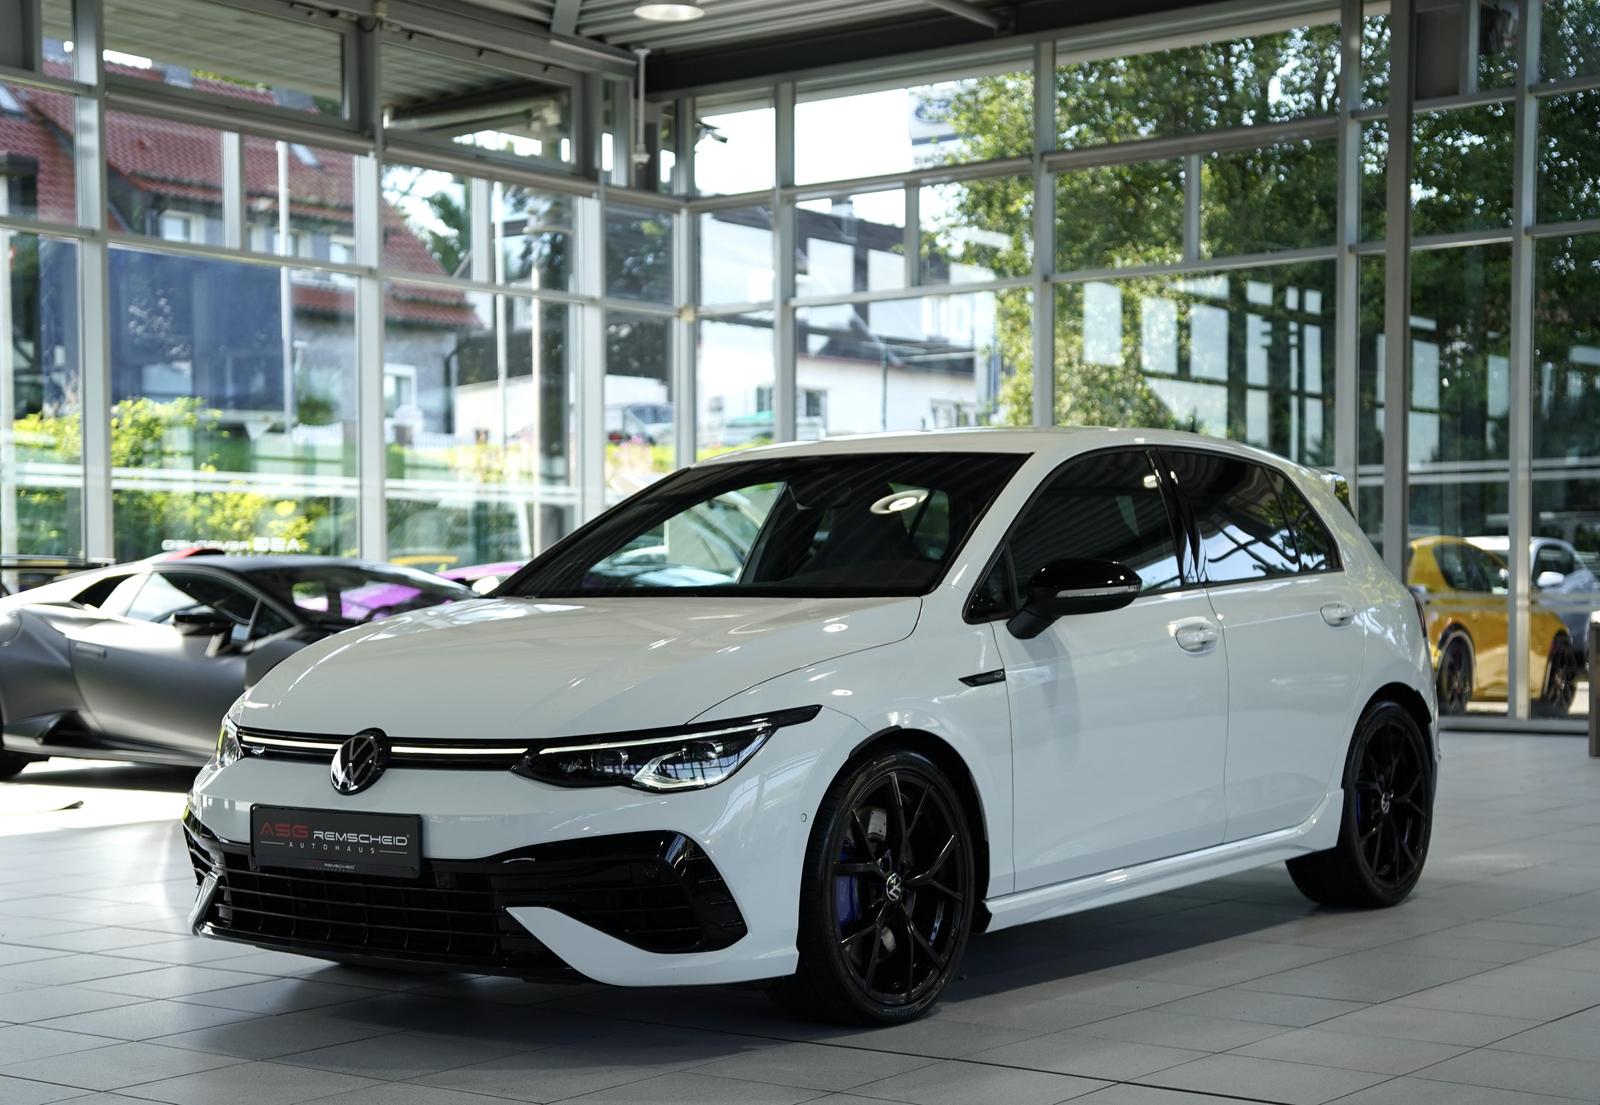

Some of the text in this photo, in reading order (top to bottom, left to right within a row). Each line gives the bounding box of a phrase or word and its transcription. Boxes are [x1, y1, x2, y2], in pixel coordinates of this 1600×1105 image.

[260, 821, 408, 846] ASG REMSCHEID
[288, 841, 375, 854] AUTOHAUS
